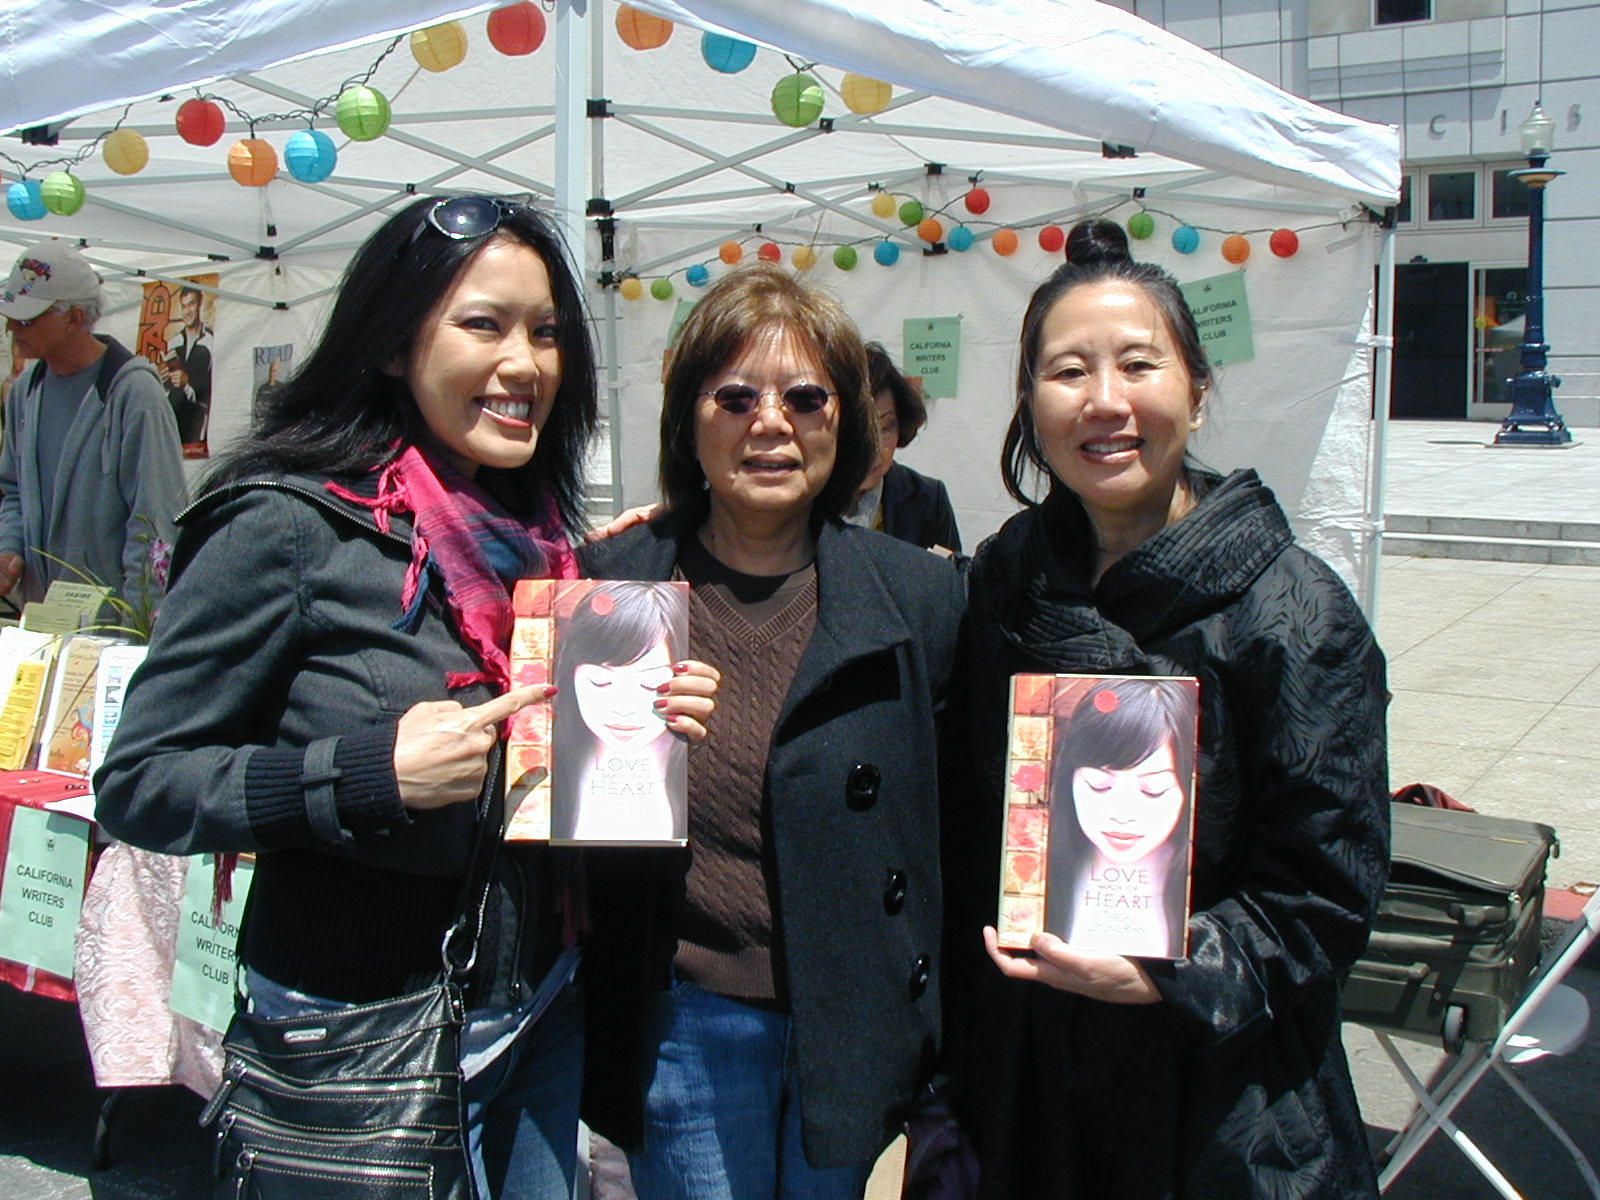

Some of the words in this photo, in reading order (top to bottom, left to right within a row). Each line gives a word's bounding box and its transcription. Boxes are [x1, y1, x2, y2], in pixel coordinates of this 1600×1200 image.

[1190, 300, 1238, 314] ALIFORNIA
[1202, 330, 1227, 341] CLUB
[910, 342, 952, 350] CALIFORNIA
[915, 354, 946, 362] WRITERS
[921, 367, 940, 375] CLUB
[595, 756, 651, 772] LOVE
[589, 780, 655, 795] HEART
[16, 864, 74, 890] CALIFORNIA
[1091, 865, 1149, 884] LOVE
[22, 887, 65, 909] WRITERS
[1084, 890, 1153, 909] HEART
[28, 911, 54, 928] CLUB
[196, 937, 237, 962] WRITER
[202, 964, 229, 985] CLUB
